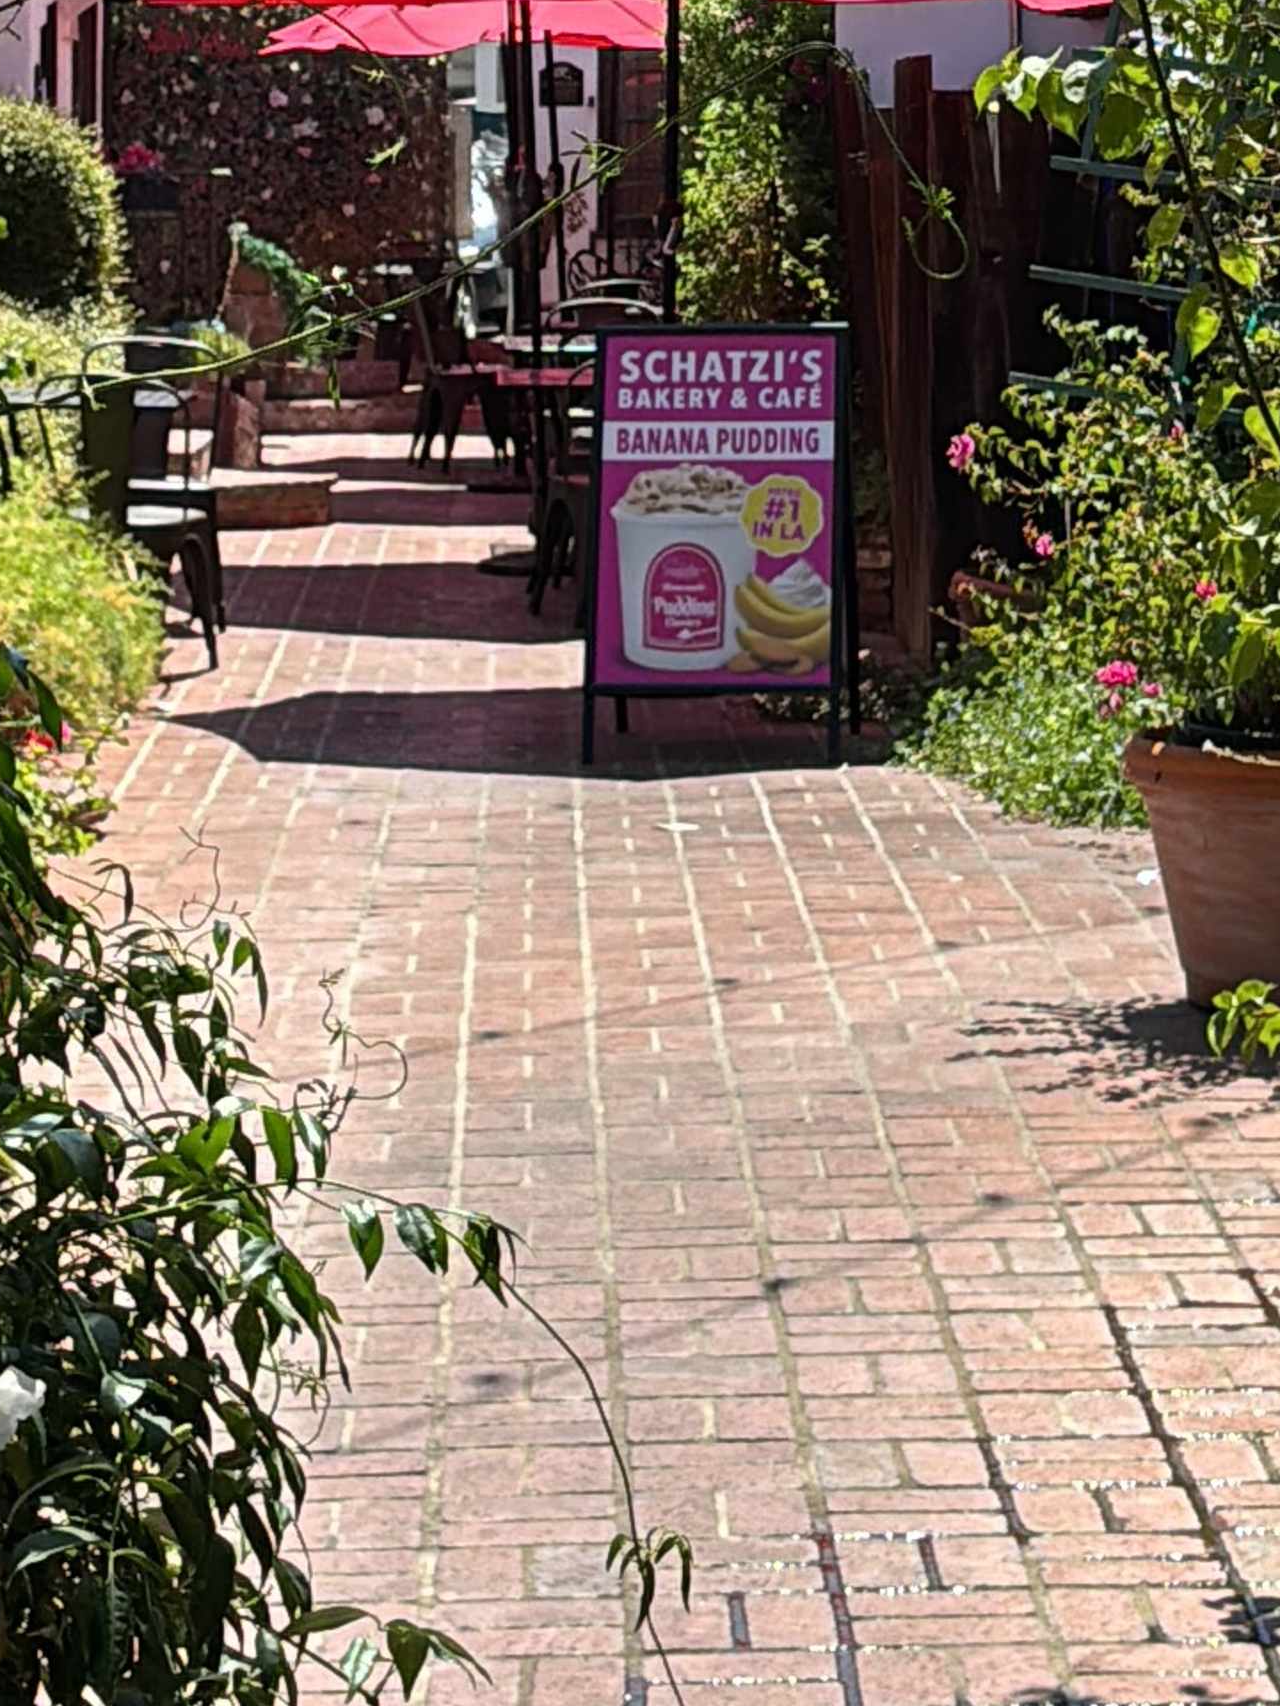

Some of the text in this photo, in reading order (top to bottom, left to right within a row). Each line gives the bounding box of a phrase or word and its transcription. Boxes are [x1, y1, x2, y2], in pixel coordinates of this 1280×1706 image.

[619, 349, 823, 383] SCHATZI'S
[617, 382, 822, 409] BAKERY & CAFÉ
[616, 427, 819, 455] BANANA PUDDING
[764, 498, 799, 522] #1
[752, 522, 805, 541] IN LA
